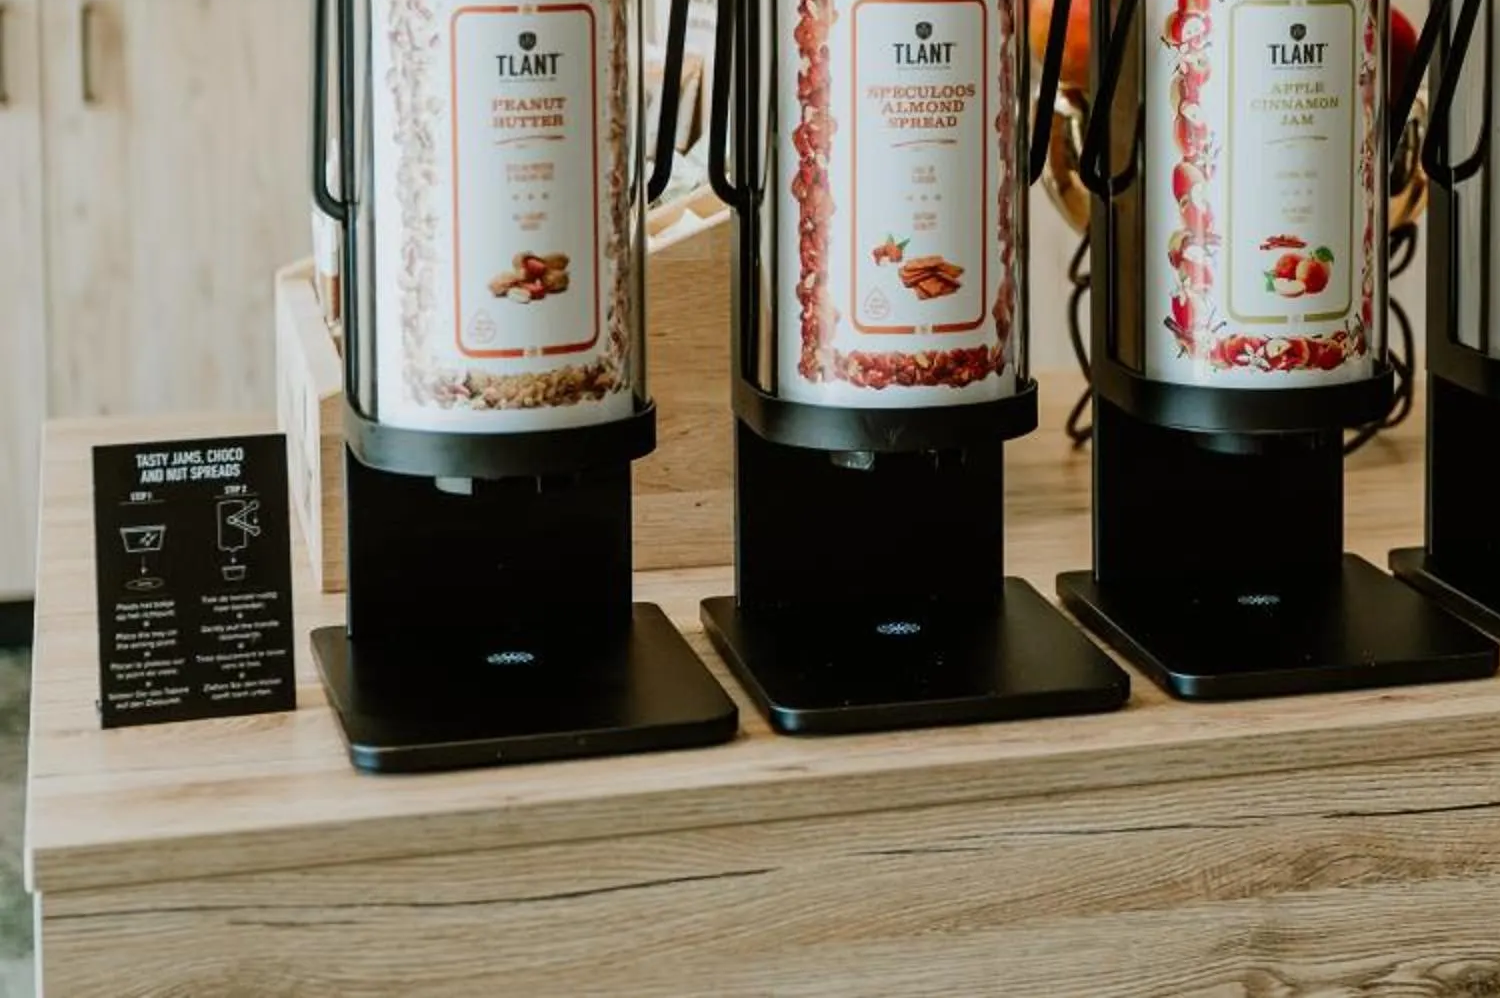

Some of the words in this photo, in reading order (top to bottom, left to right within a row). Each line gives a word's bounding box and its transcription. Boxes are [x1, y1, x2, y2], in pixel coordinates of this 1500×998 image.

[893, 43, 953, 64] TLANT
[1268, 43, 1325, 64] TLANT
[496, 53, 561, 76] TLANT
[492, 97, 567, 111] PEANUT
[882, 100, 965, 116] ALMOND
[135, 452, 169, 469] TASTY
[206, 447, 244, 463] CHOCO
[140, 468, 164, 484] AND
[165, 466, 188, 482] NUT
[189, 463, 241, 480] SPREADS
